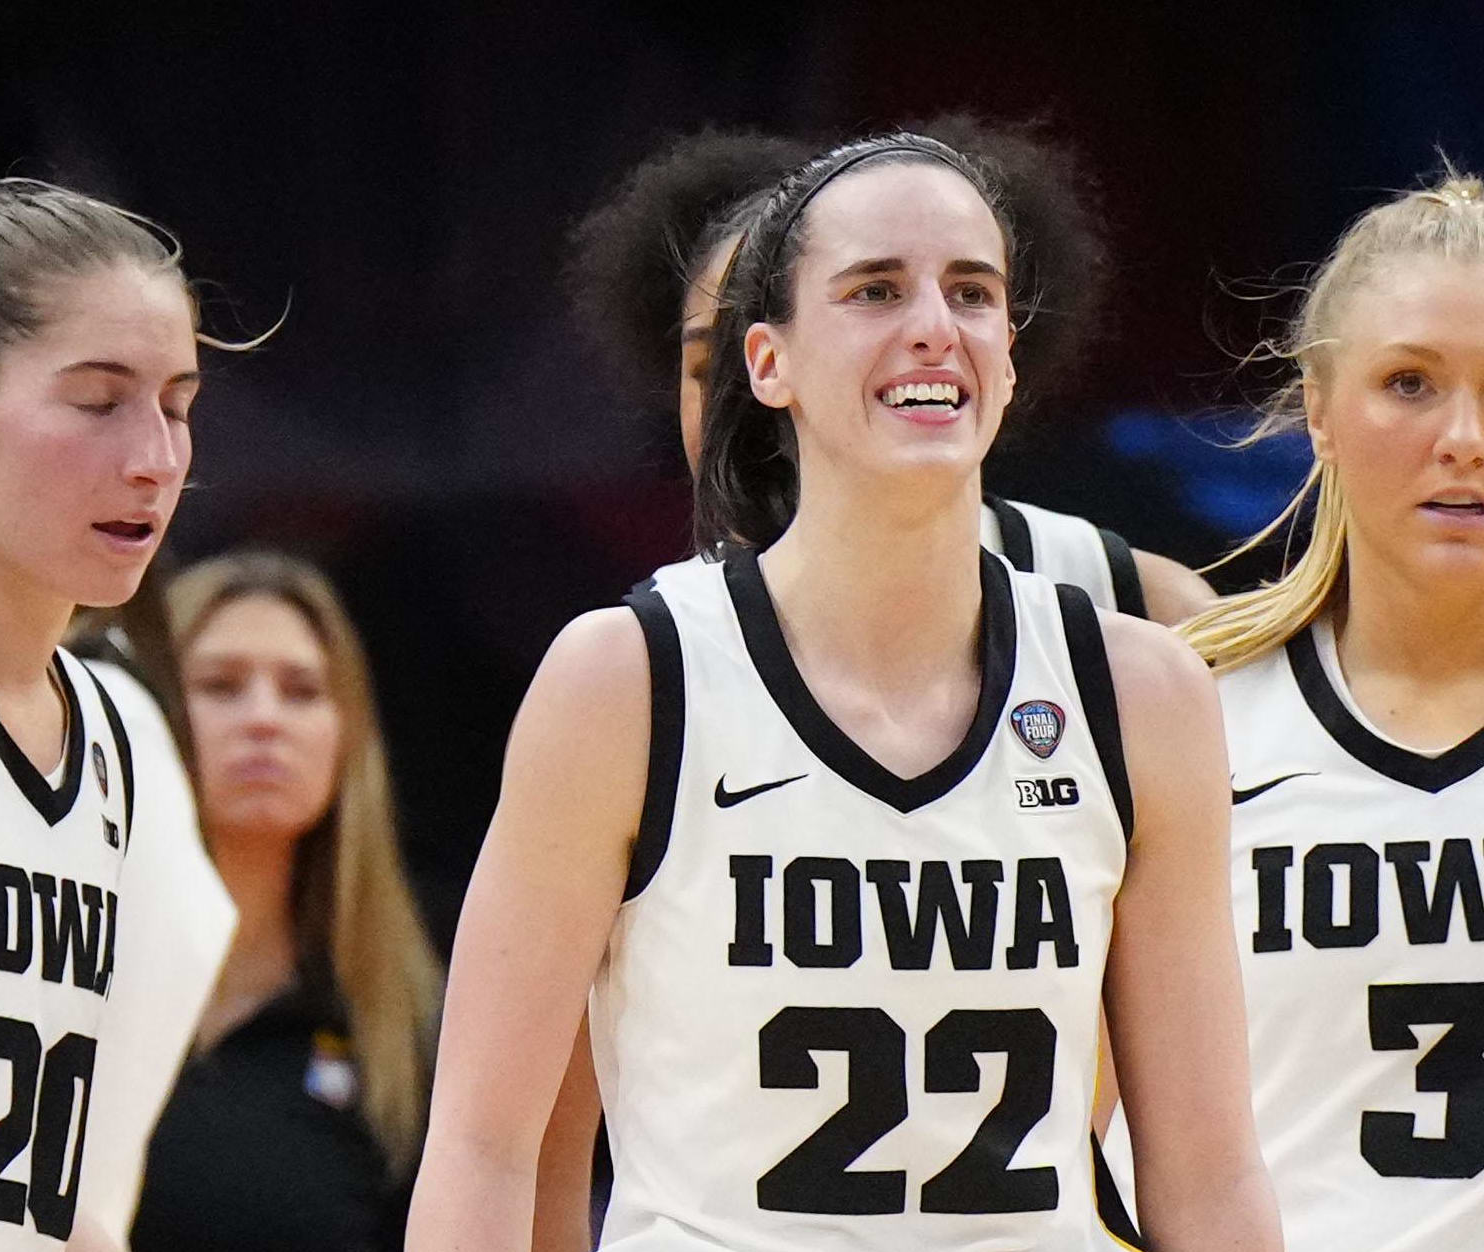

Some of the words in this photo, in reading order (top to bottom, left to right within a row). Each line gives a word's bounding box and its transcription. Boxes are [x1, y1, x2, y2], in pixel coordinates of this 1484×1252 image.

[1023, 713, 1054, 727] FINAL
[1026, 725, 1056, 739] FOUR
[727, 854, 1079, 972] IOWA
[757, 1005, 1060, 1216] 22
